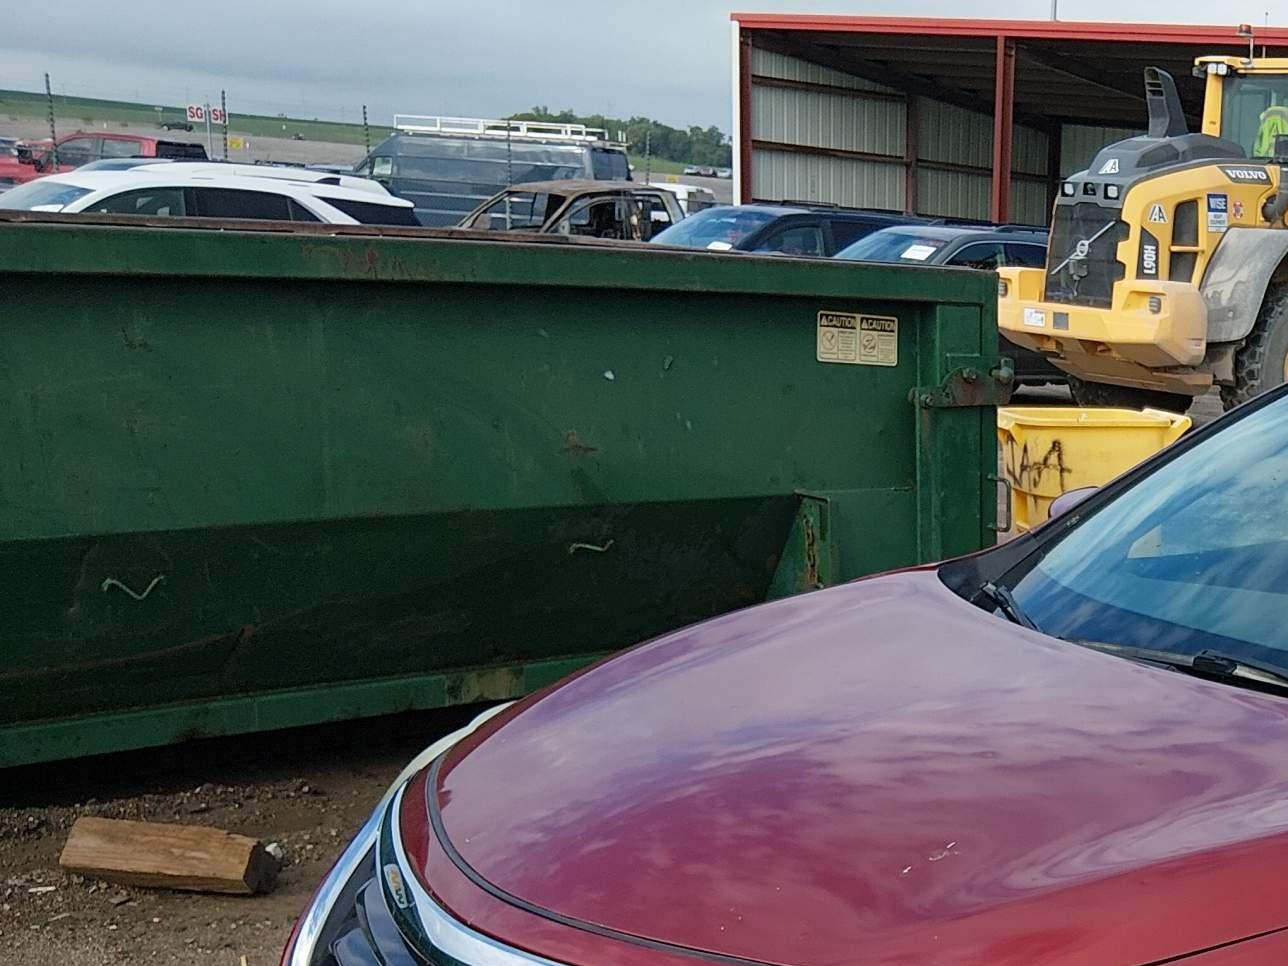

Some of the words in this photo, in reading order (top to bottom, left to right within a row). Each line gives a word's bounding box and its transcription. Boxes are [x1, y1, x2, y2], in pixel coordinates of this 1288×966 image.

[188, 106, 203, 119] SG
[1225, 169, 1267, 179] VOLVO
[1143, 245, 1156, 274] L90H
